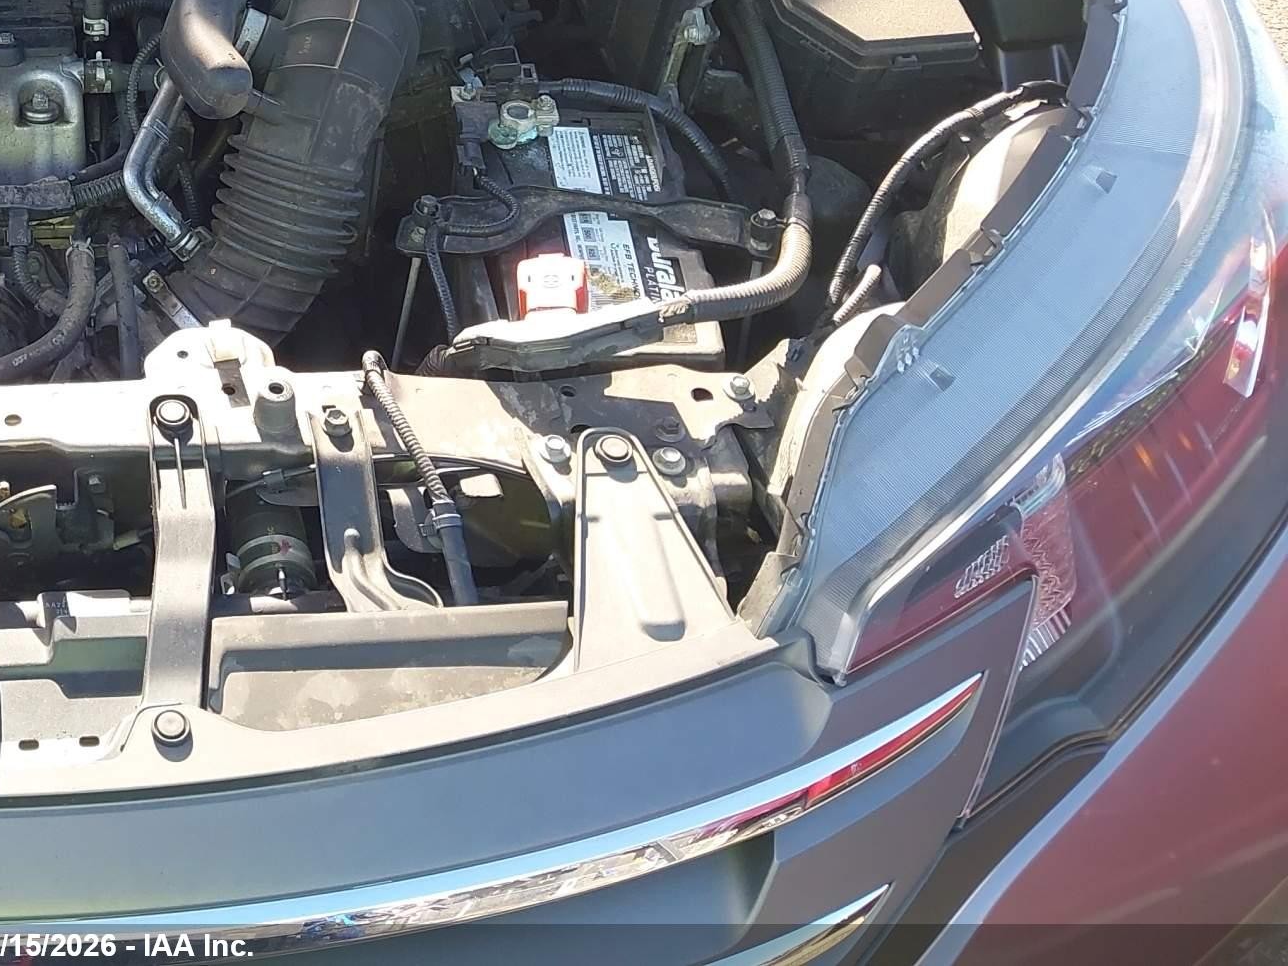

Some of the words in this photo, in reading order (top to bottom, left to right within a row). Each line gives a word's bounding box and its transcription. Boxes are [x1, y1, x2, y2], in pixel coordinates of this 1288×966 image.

[626, 262, 642, 300] TECHNO
[643, 266, 663, 304] PLATIN
[646, 236, 687, 303] Durala
